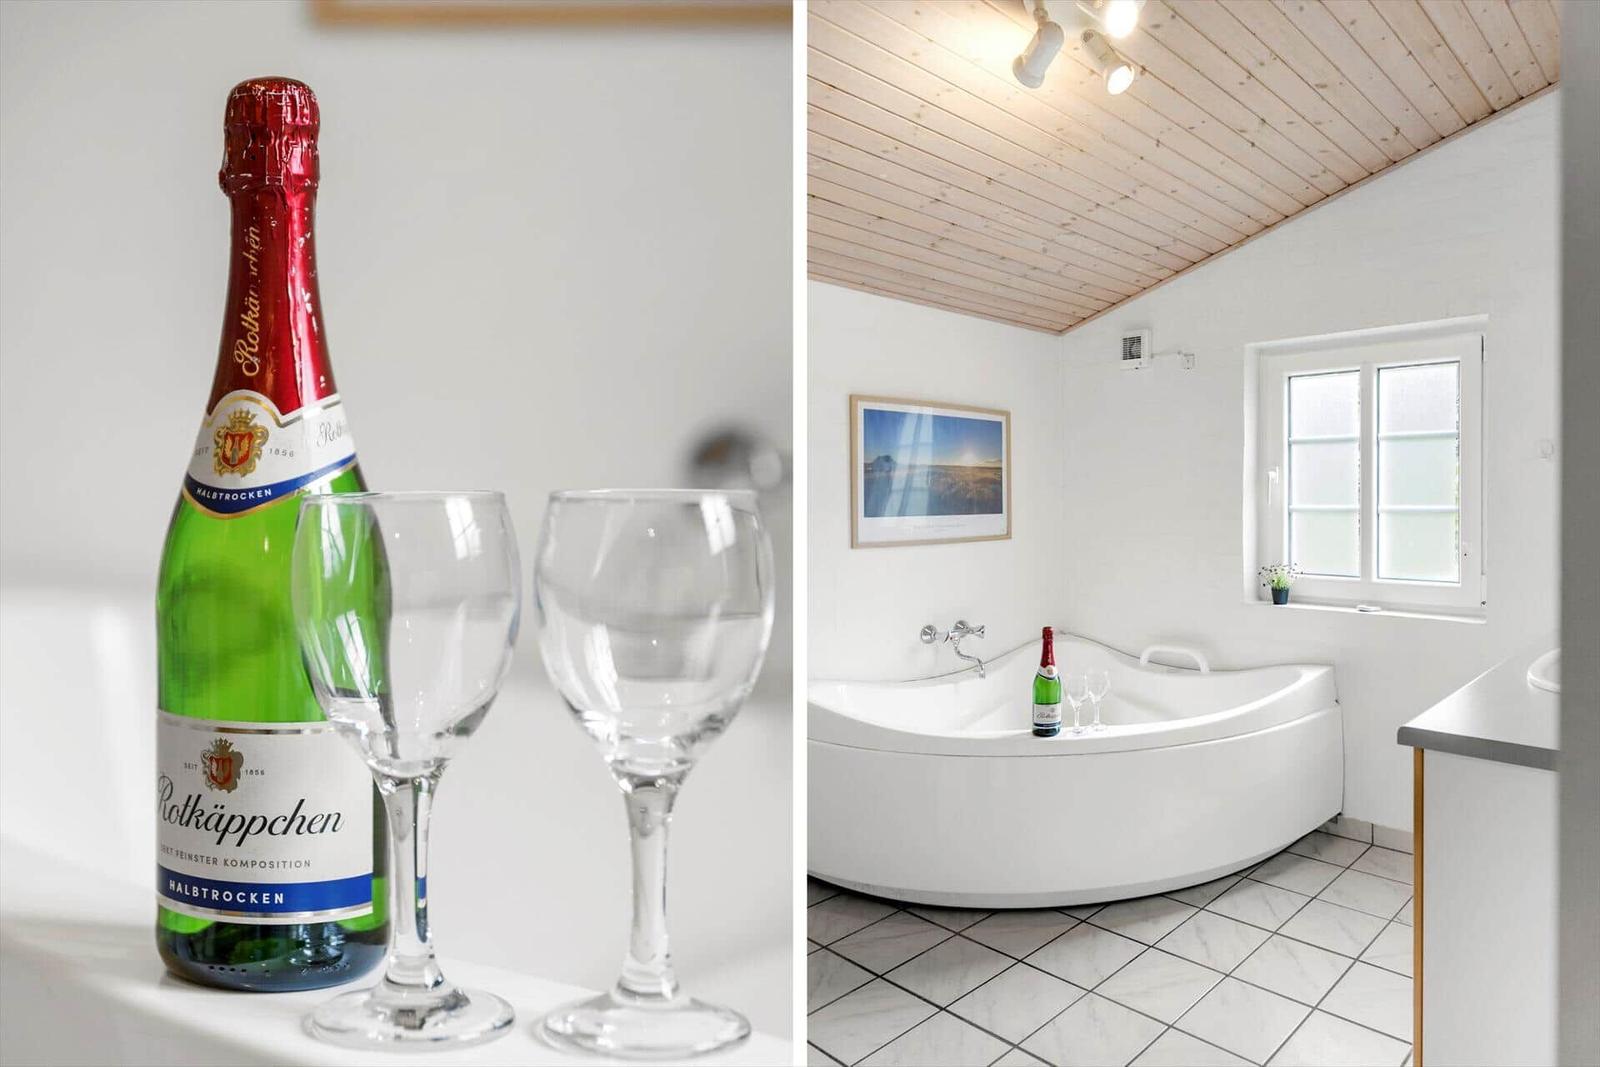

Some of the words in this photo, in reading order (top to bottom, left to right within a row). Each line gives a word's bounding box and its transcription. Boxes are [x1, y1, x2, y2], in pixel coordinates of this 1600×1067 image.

[268, 448, 295, 458] 1856
[195, 487, 272, 501] HALBTROCKEN
[184, 762, 198, 771] SEIT
[158, 775, 345, 847] Rotkäppchen
[175, 849, 218, 866] FEINSTER
[223, 858, 311, 869] KOMPOSITION
[169, 879, 284, 904] HALBTROCKEN
